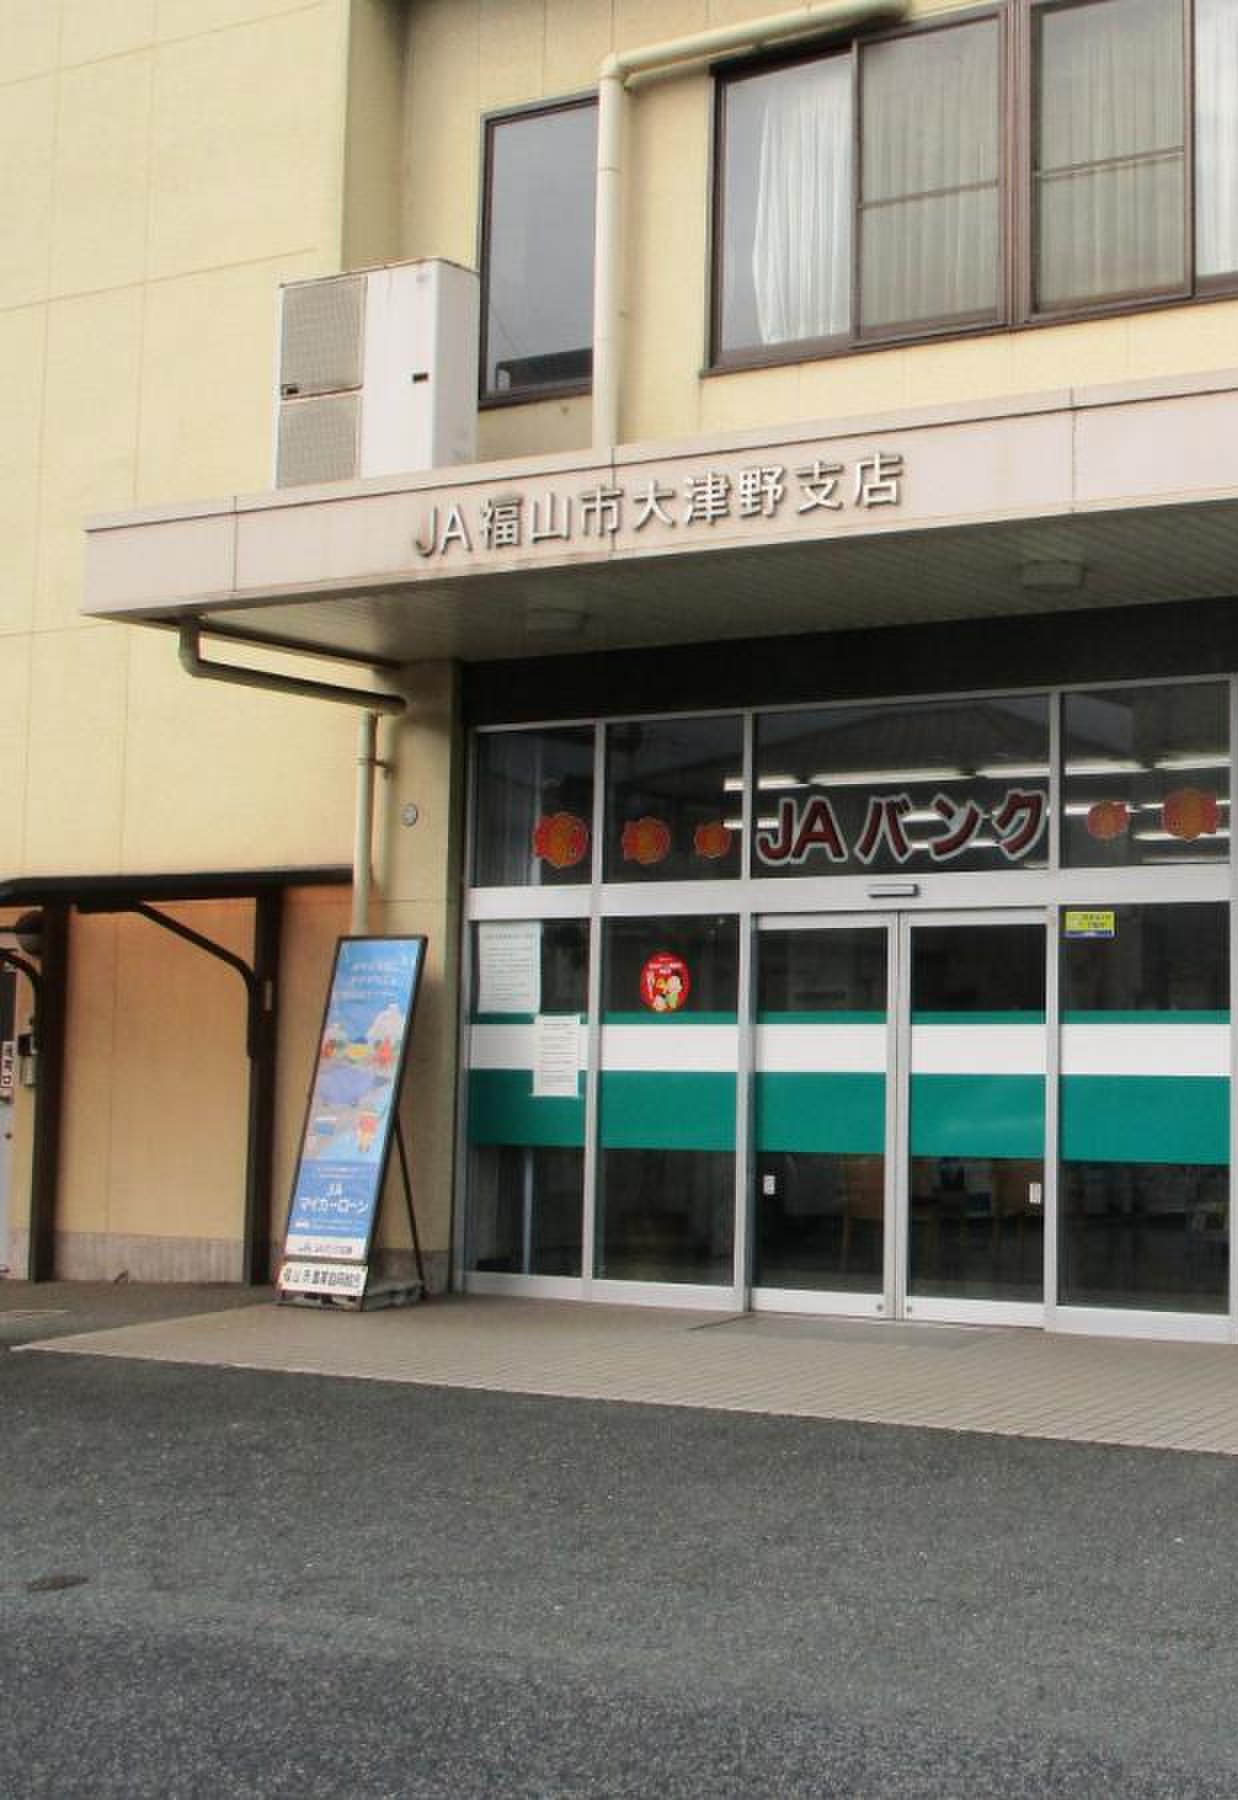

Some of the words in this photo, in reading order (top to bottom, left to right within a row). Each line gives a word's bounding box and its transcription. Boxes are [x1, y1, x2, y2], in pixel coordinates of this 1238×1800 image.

[414, 451, 905, 558] JA福山市大津野支店
[756, 789, 1048, 865] JAバンク
